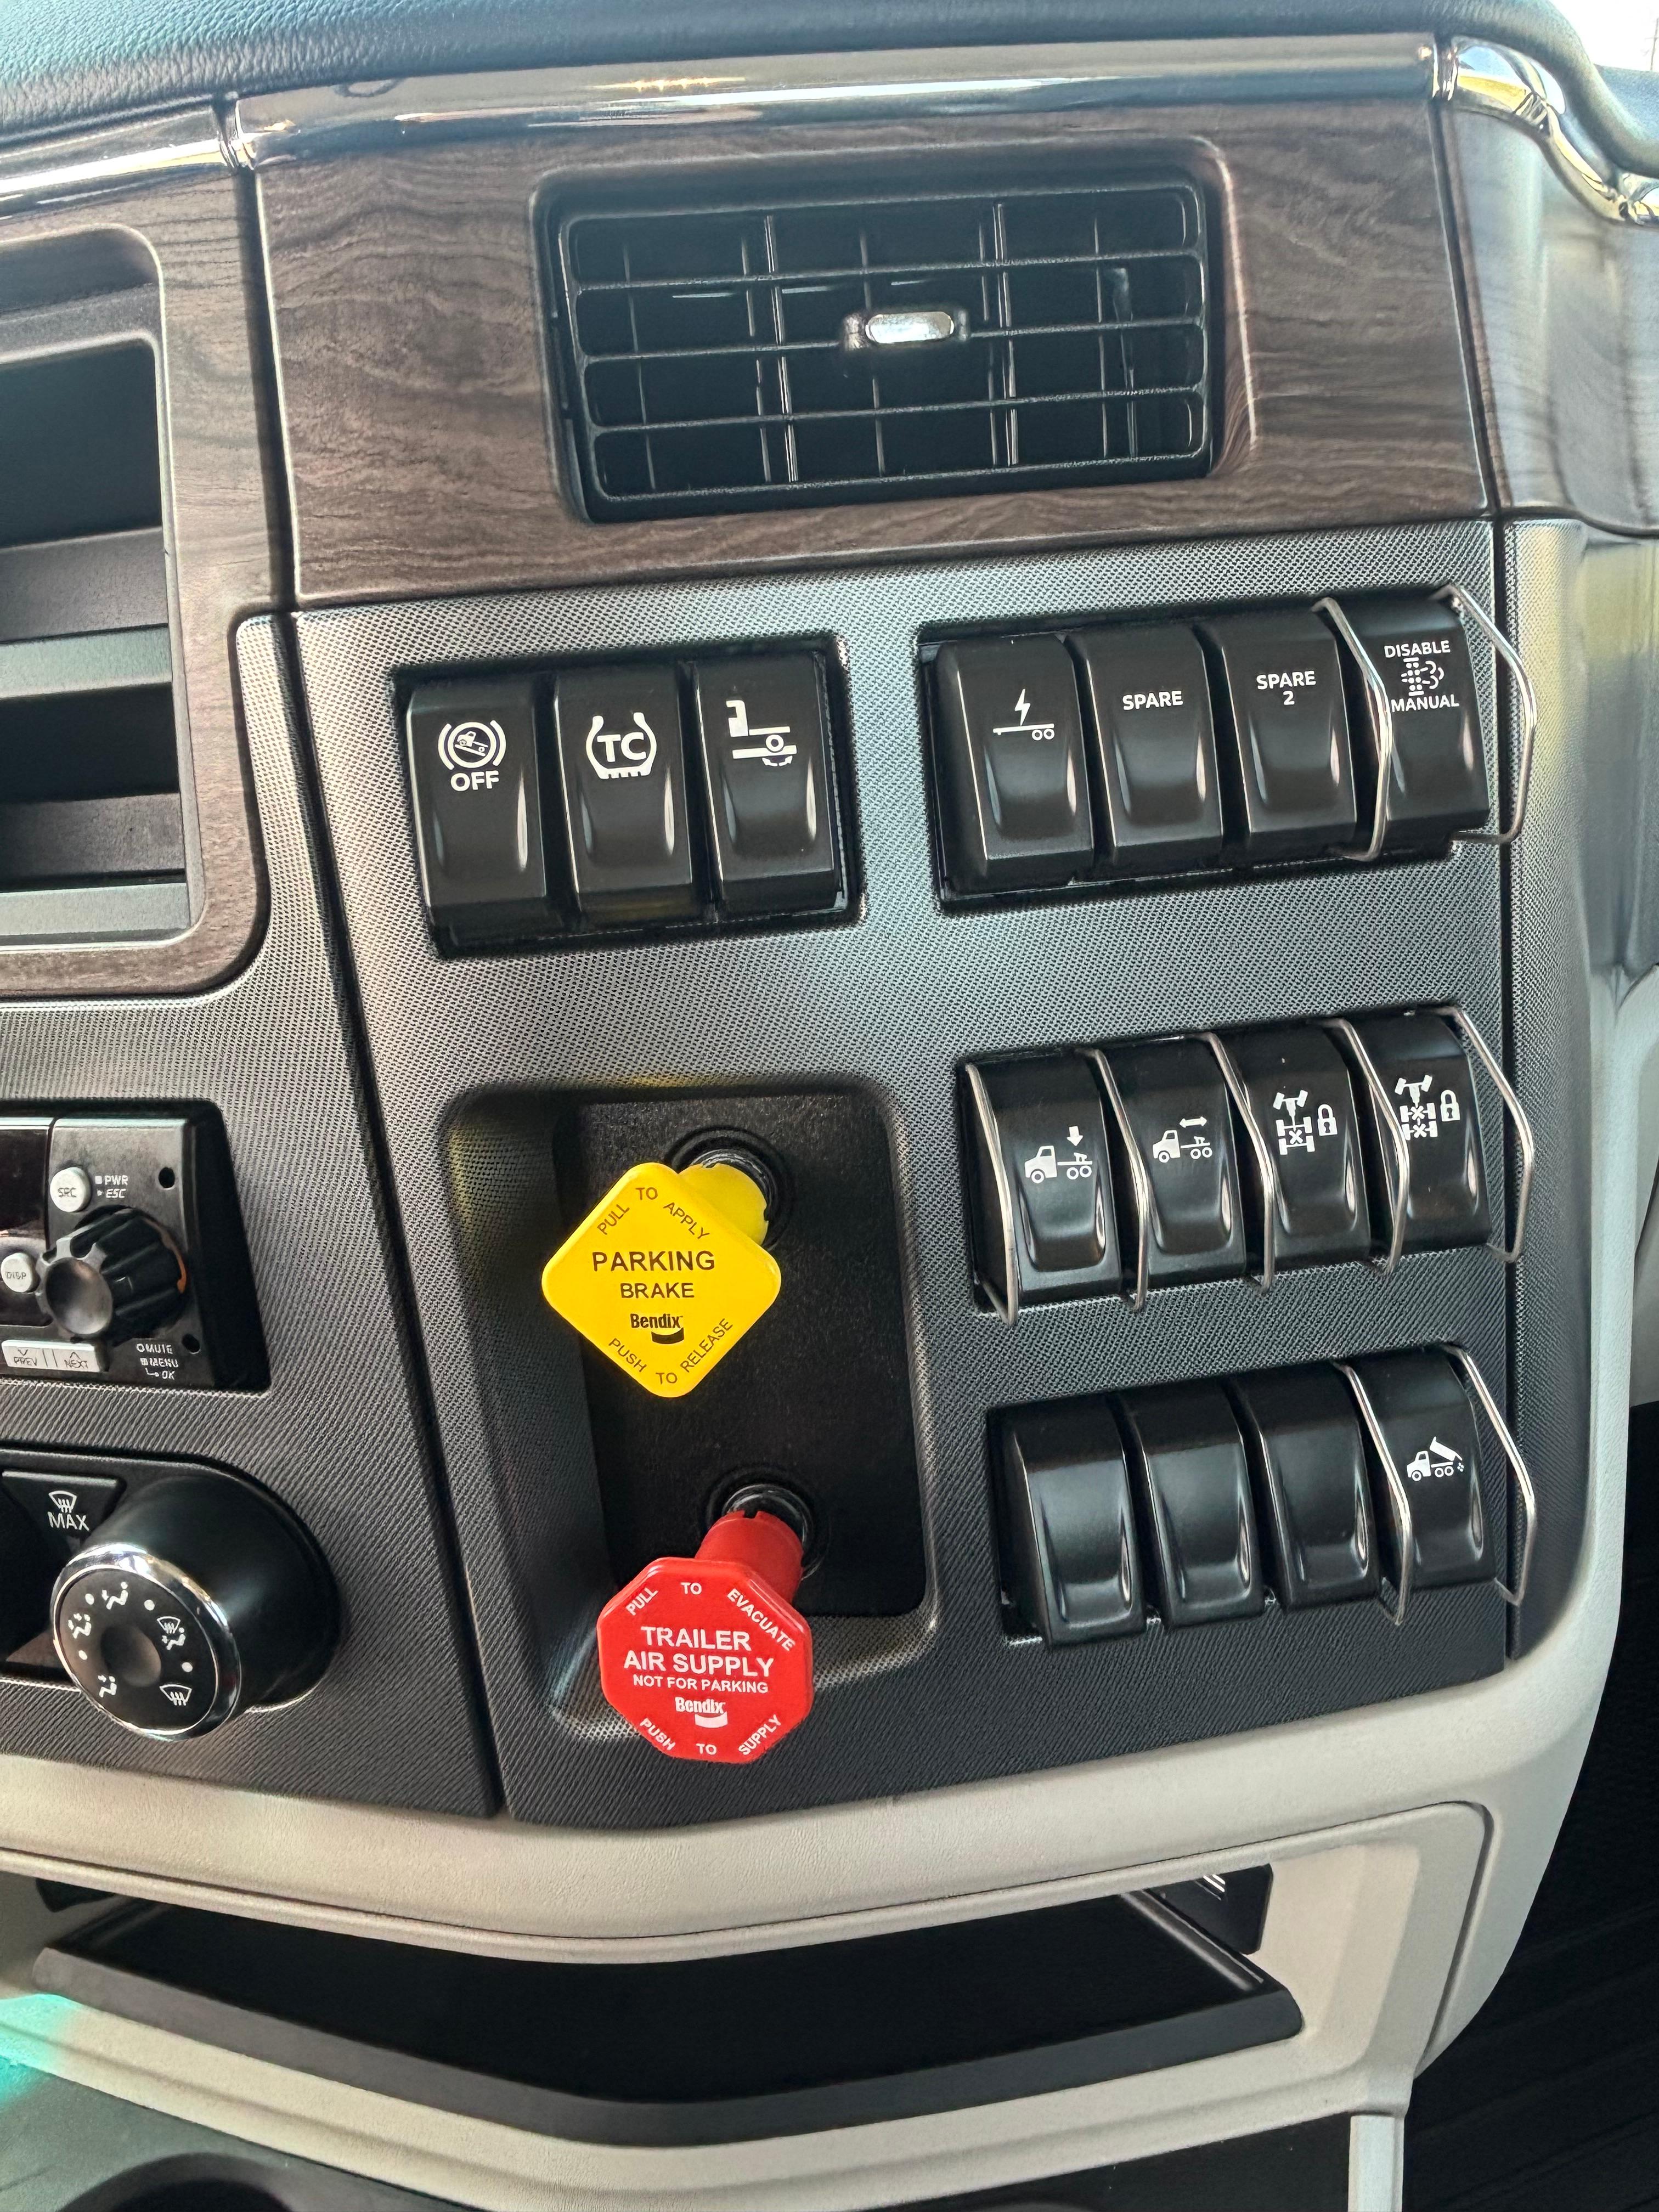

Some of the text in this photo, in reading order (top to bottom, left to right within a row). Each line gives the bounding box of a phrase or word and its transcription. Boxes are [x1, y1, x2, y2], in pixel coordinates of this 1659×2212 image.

[1384, 640, 1451, 659] DISABLE
[1256, 670, 1316, 690] SPARE
[1122, 690, 1183, 710] SPARE
[1283, 691, 1295, 706] 2
[1390, 693, 1460, 713] MANUAL
[596, 732, 647, 763] TC
[450, 772, 499, 792] OFF
[105, 1175, 128, 1186] PWR
[106, 1188, 126, 1198] ESC
[597, 1187, 710, 1240] PULL TO APPLY
[592, 1250, 715, 1272] PARKING
[620, 1283, 695, 1299] BRAKE
[630, 1313, 681, 1328] Bendix
[608, 1318, 733, 1385] PUSH TO RELEASE
[162, 1371, 175, 1380] OK
[48, 1512, 89, 1531] MAX
[626, 1582, 795, 1651] PULL TO EVACUATE
[641, 1626, 752, 1651] TRAILER
[623, 1650, 774, 1677] AIR SUPPLY
[633, 1674, 769, 1694] NOT FOR PARKING
[675, 1696, 724, 1714] Bendix
[640, 1714, 782, 1756] PUSH TO SUPPLY
